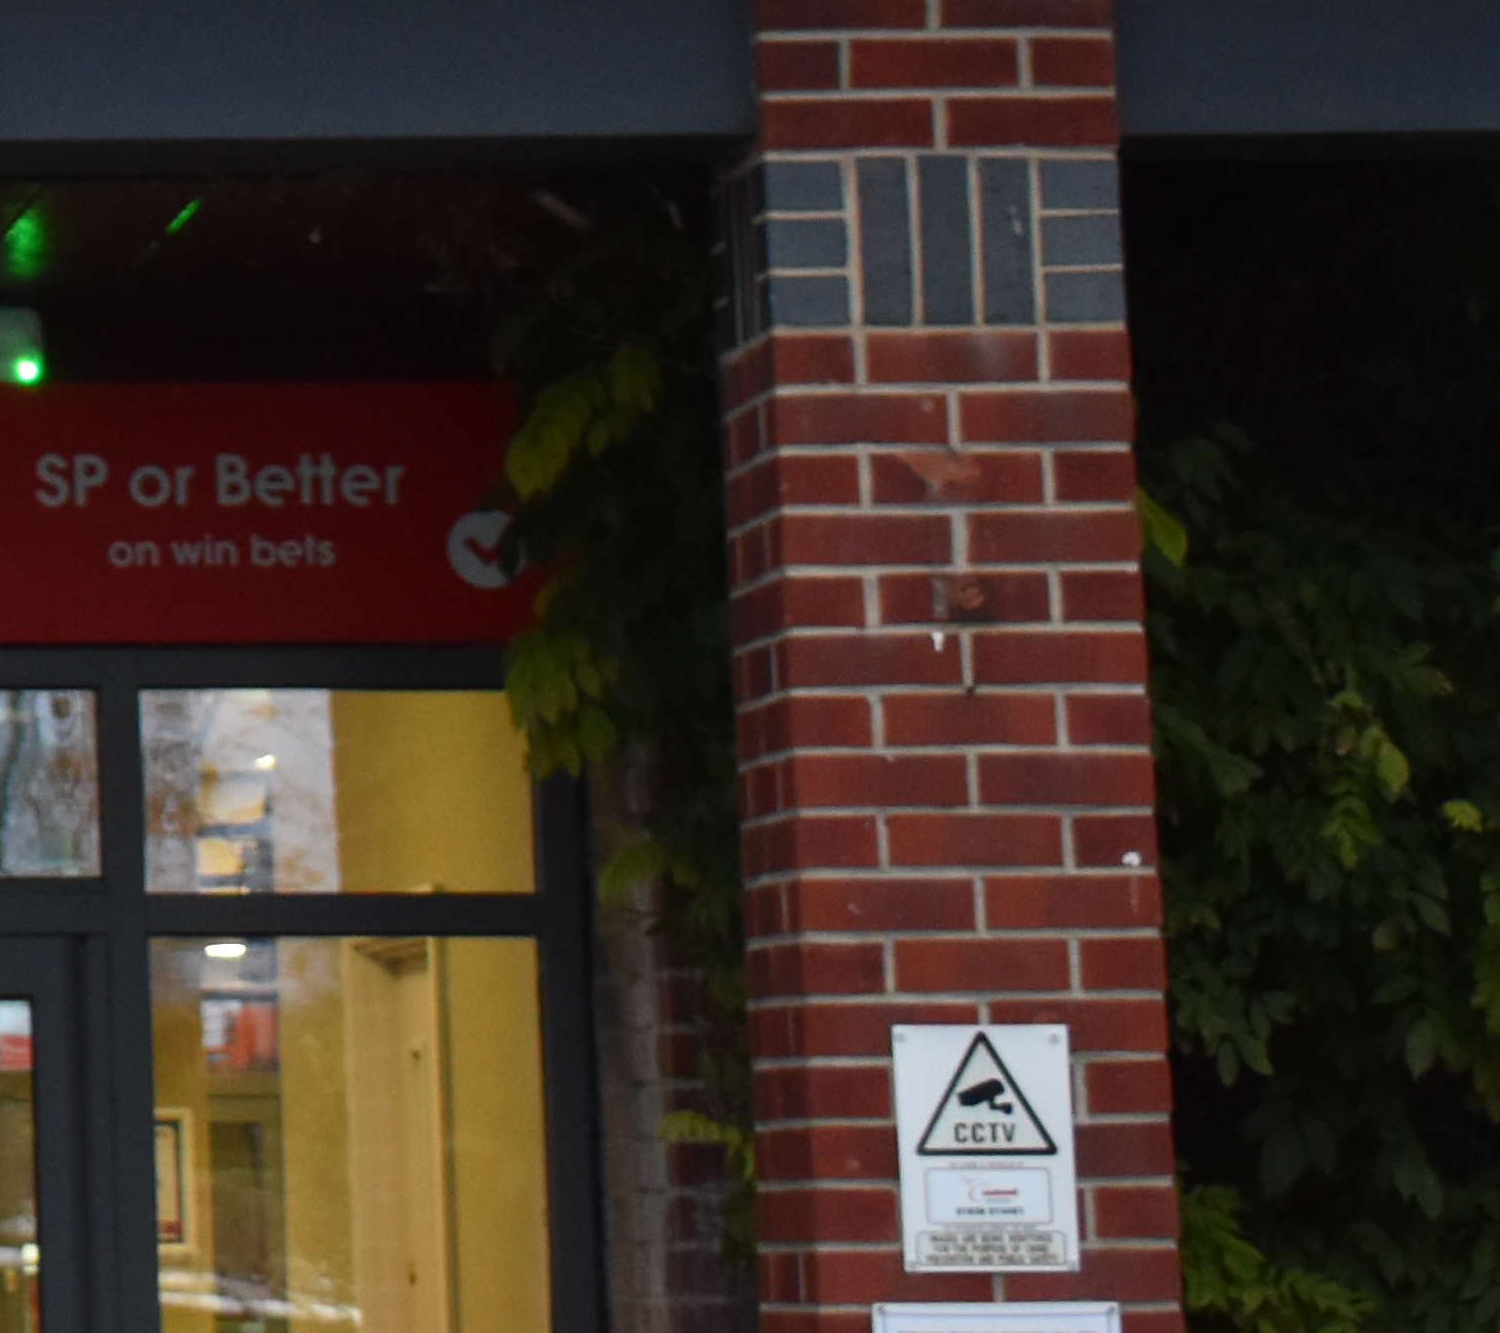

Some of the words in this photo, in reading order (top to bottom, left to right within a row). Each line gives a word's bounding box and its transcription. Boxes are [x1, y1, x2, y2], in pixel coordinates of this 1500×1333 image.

[35, 452, 109, 508] SP
[128, 464, 197, 508] or
[214, 452, 405, 507] Better
[107, 540, 161, 569] on
[171, 534, 238, 568] win
[251, 534, 336, 568] bets
[953, 1121, 1017, 1144] CCTV
